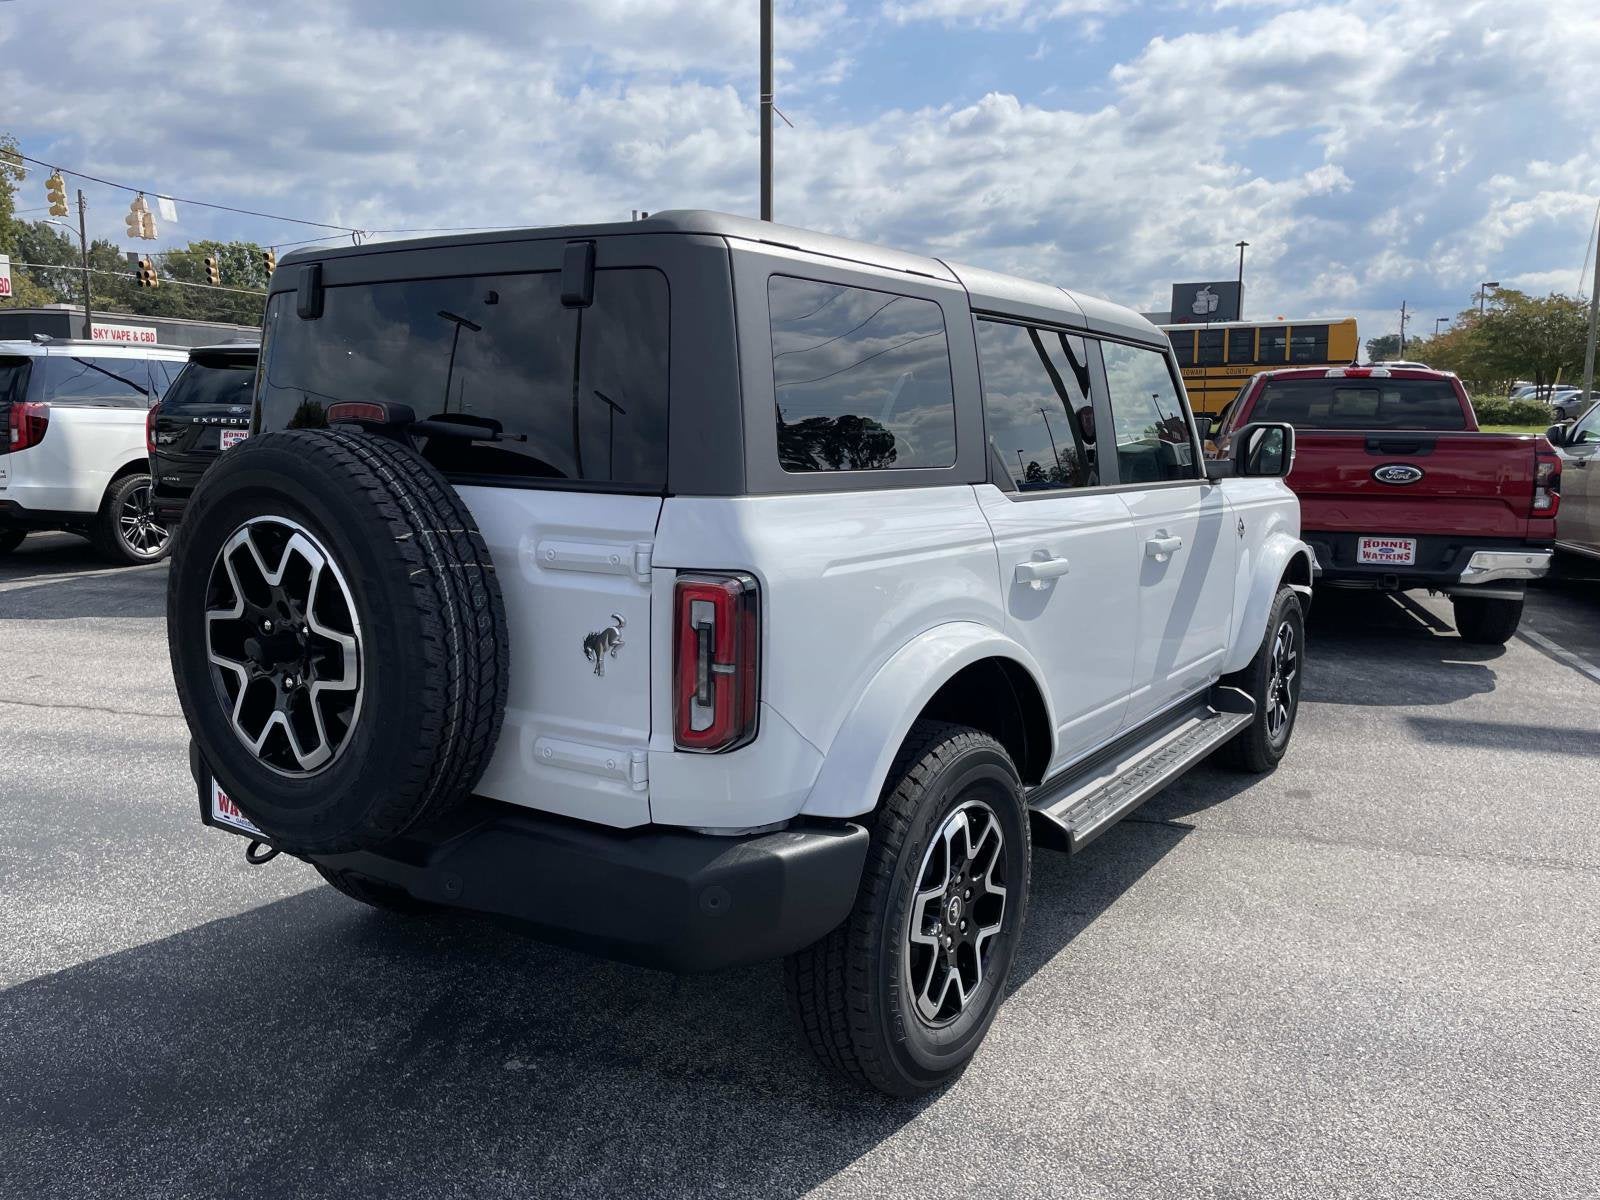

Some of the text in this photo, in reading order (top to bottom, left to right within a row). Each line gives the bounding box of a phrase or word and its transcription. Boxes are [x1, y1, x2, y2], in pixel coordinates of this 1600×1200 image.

[93, 328, 156, 343] SKY VAPE & CBD
[1225, 367, 1249, 375] COUNTY
[1386, 468, 1412, 480] Ford
[1363, 540, 1411, 550] RONNIE
[1362, 551, 1411, 561] WATKINS
